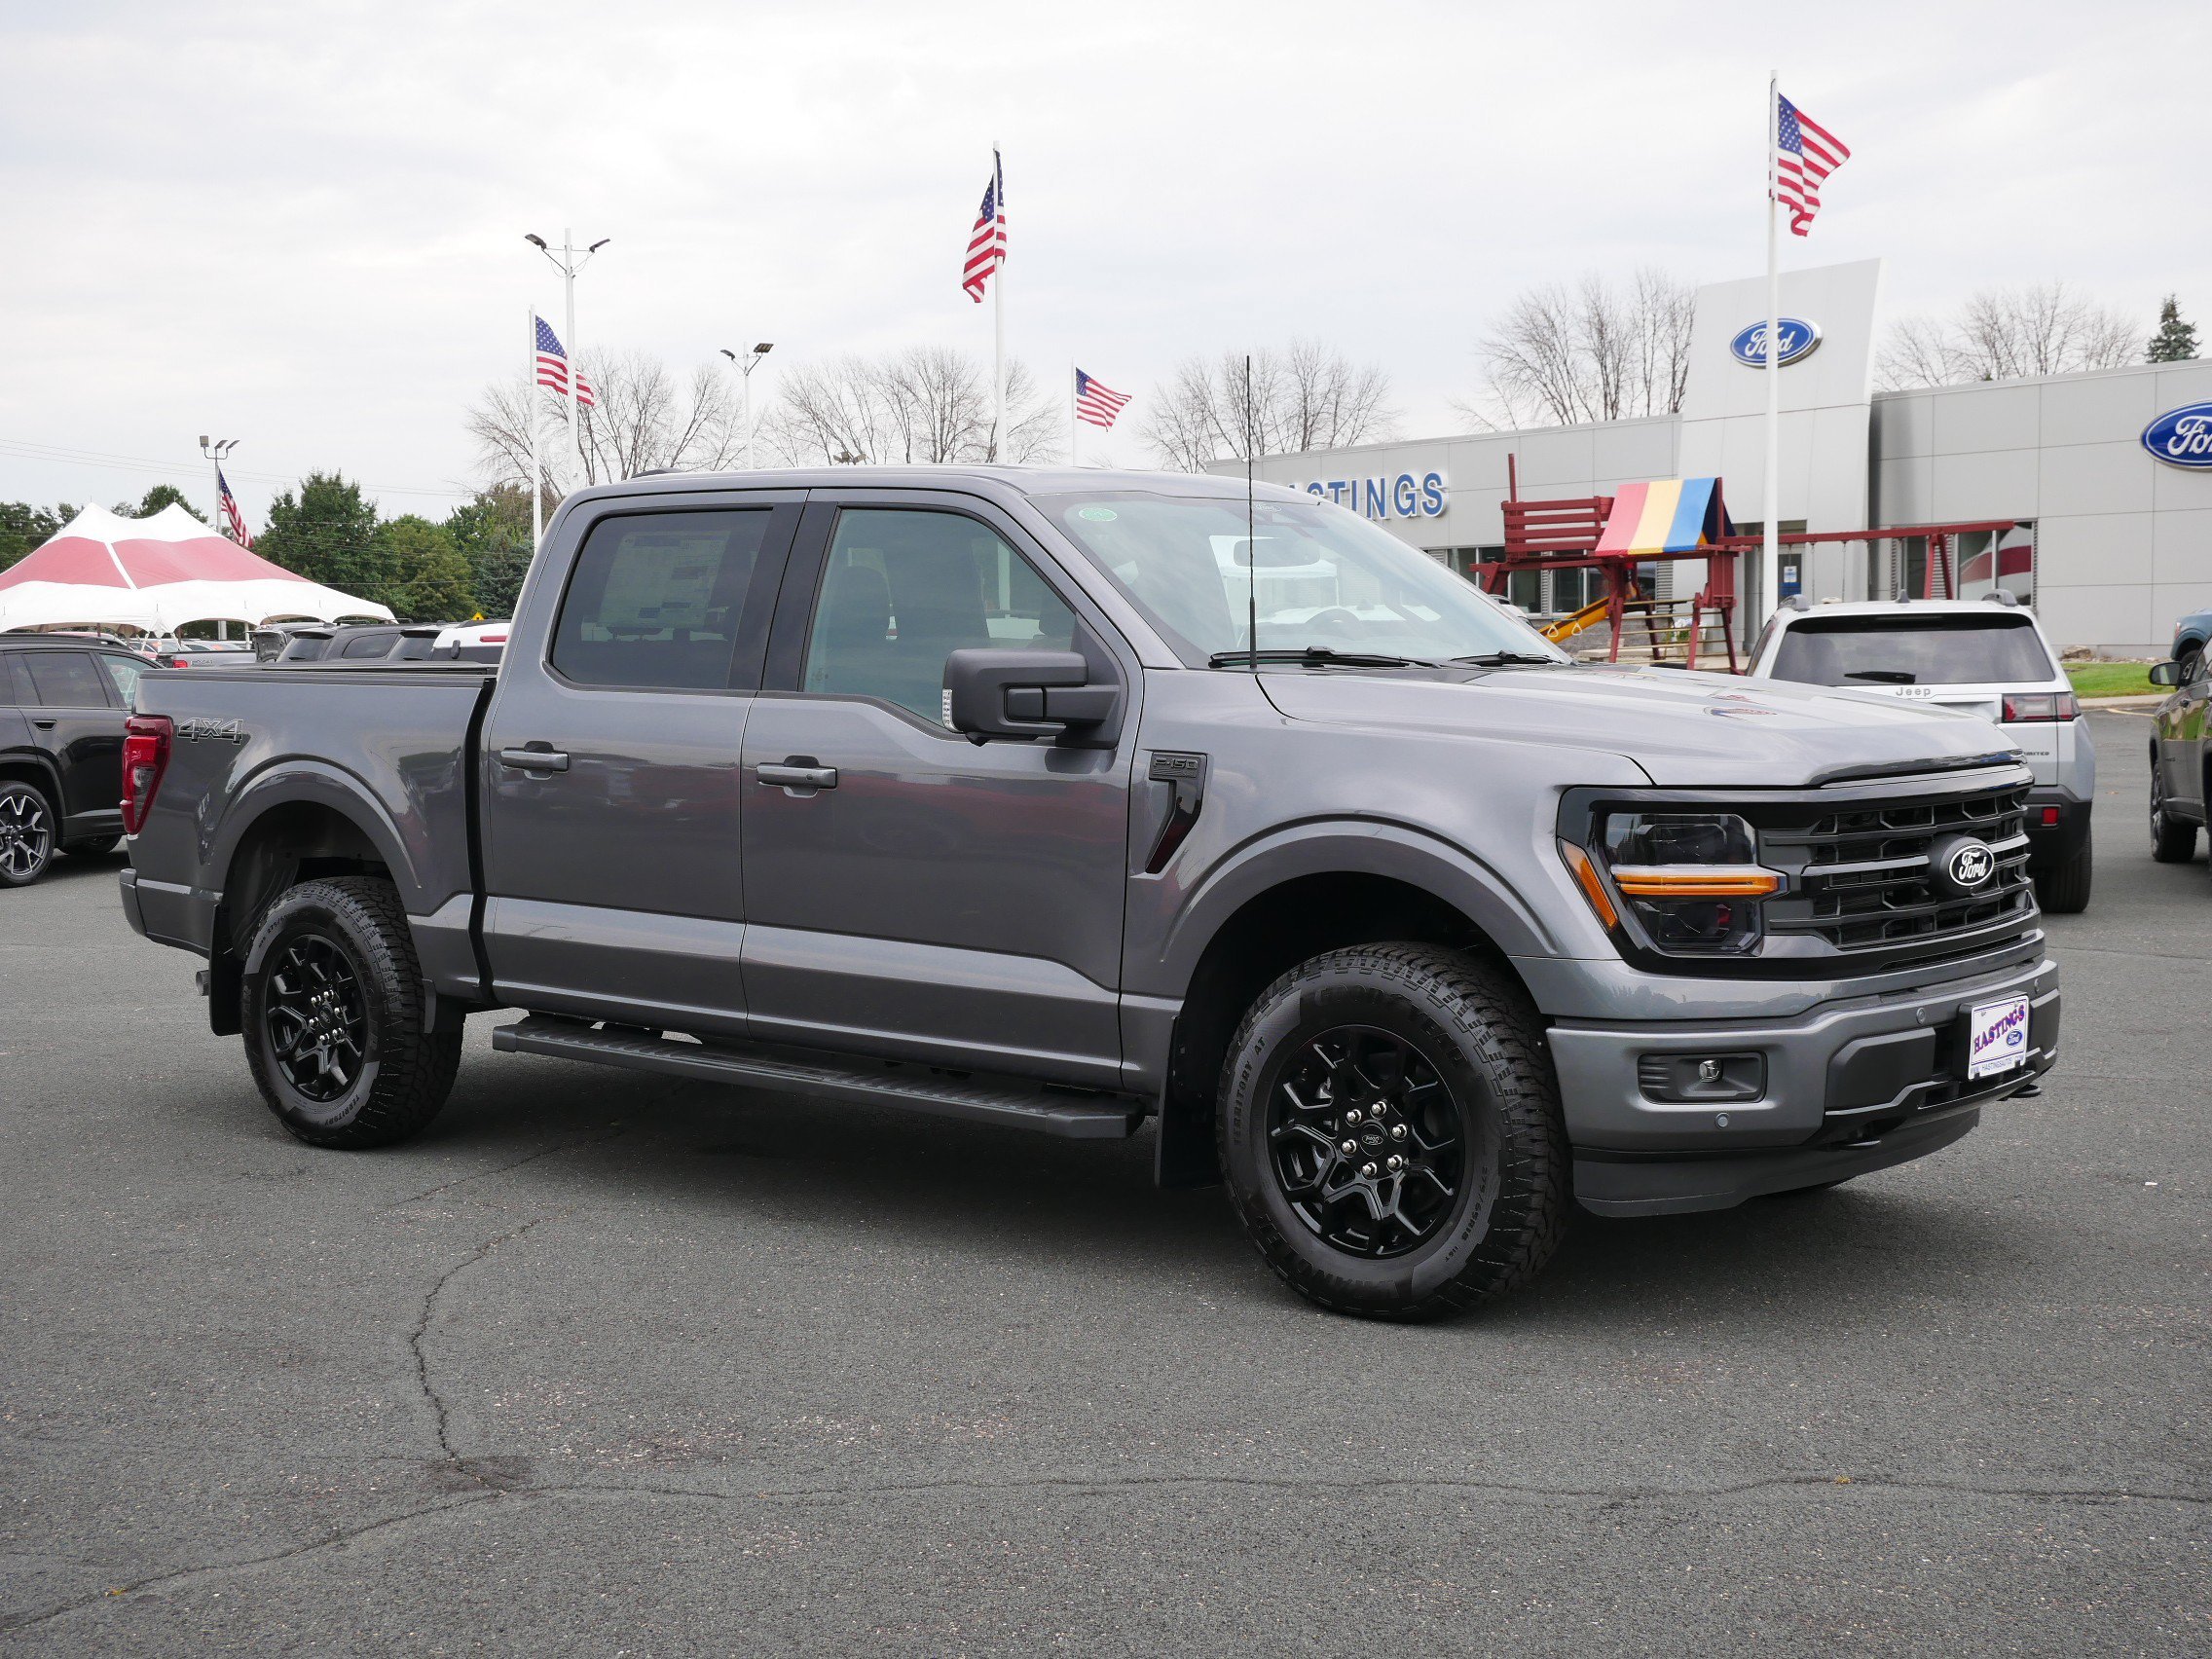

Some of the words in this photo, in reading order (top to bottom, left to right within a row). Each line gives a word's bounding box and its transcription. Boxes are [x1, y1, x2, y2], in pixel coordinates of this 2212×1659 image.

[1744, 325, 1797, 357] Fod
[1895, 686, 1932, 697] Jeep
[1153, 756, 1198, 770] F-150
[1958, 851, 1988, 880] Ford
[1972, 1004, 2025, 1055] HASTINGS
